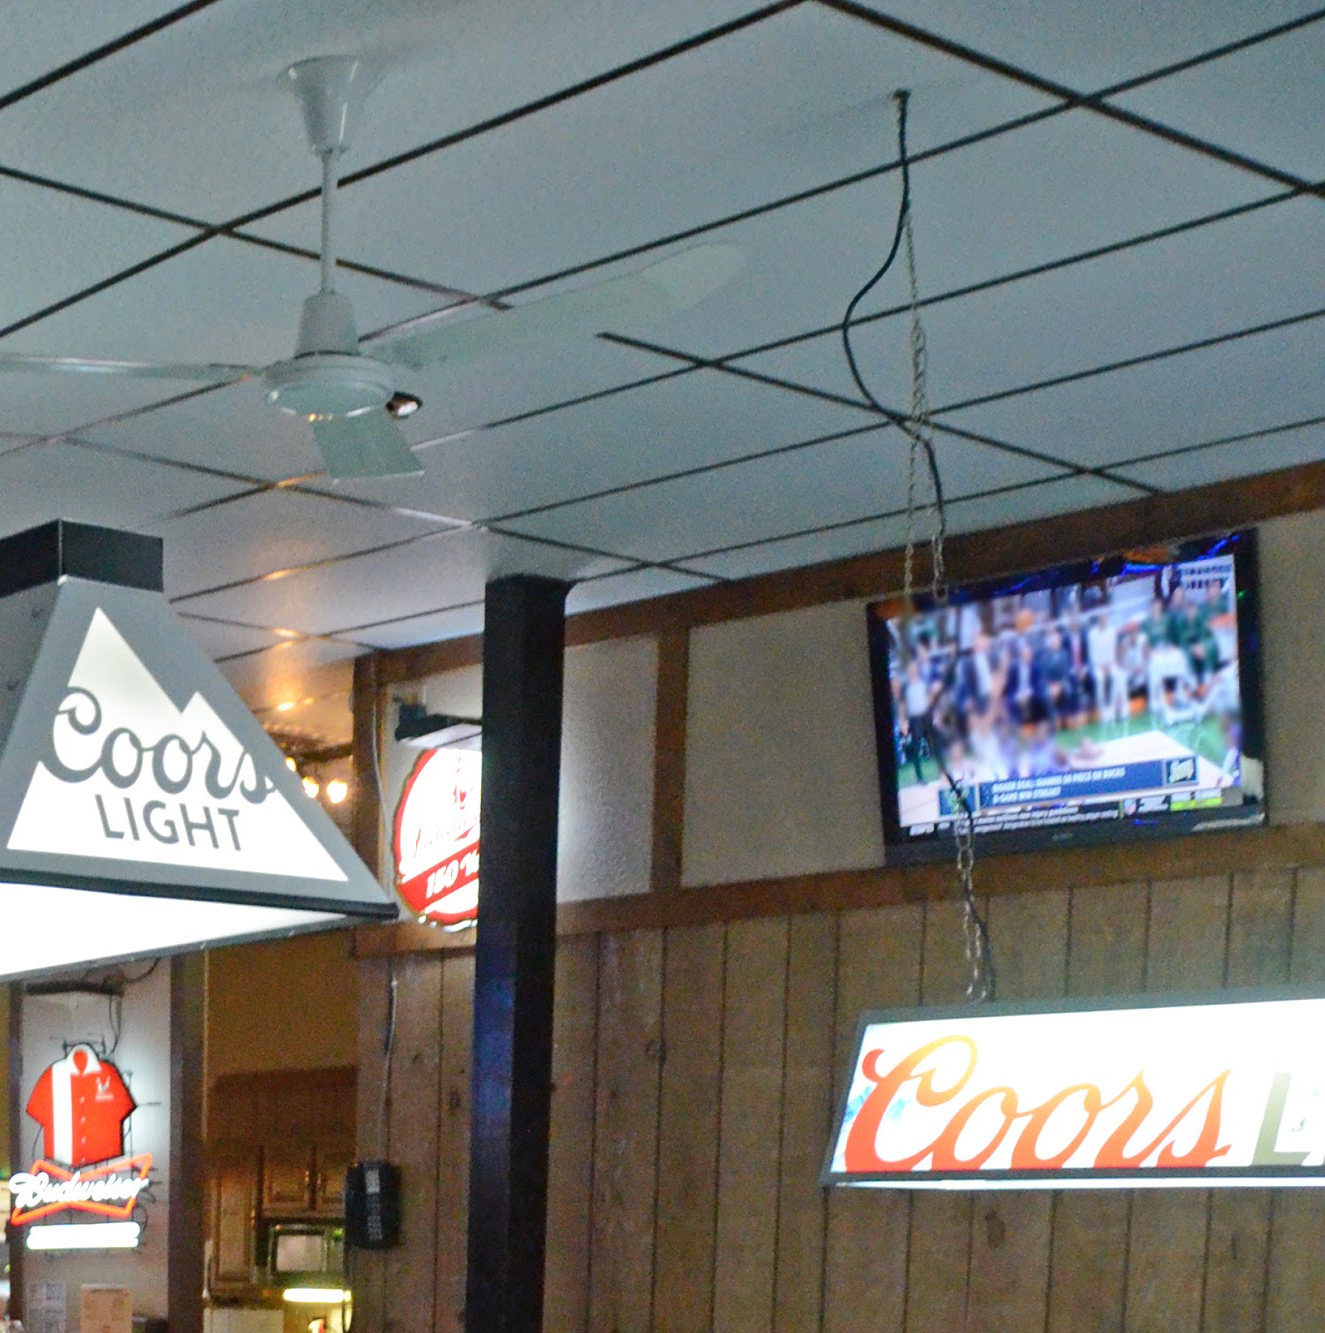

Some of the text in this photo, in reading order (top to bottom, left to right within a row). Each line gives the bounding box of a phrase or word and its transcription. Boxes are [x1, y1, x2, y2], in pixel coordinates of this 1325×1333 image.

[40, 686, 277, 805] Coors
[94, 793, 242, 852] LIGHT
[426, 859, 460, 899] 150
[844, 1034, 1232, 1173] Coors
[9, 1171, 150, 1208] Budweiser
